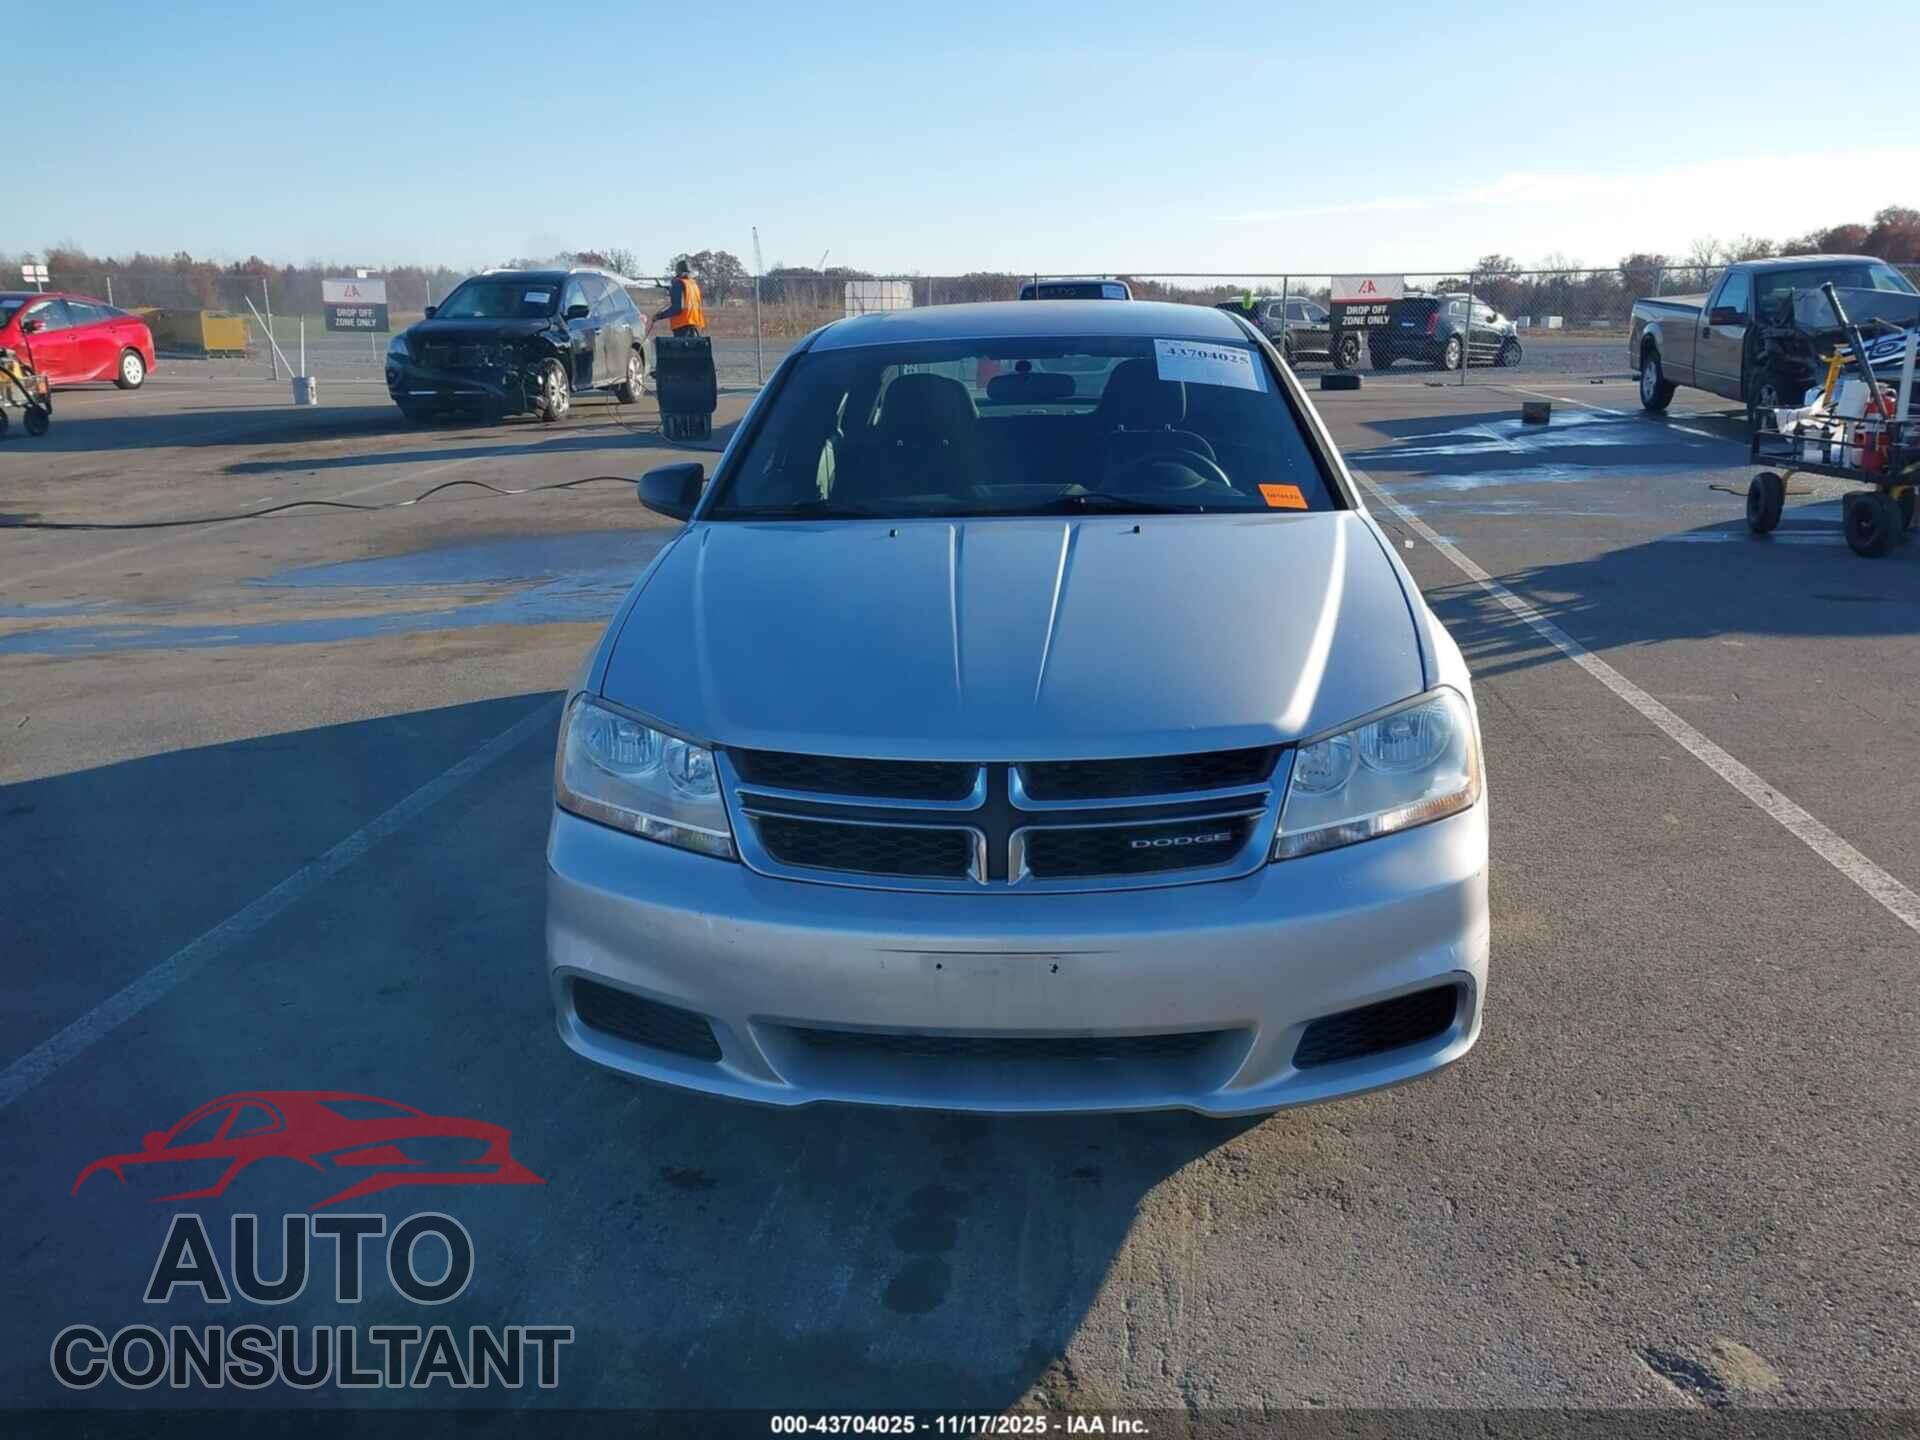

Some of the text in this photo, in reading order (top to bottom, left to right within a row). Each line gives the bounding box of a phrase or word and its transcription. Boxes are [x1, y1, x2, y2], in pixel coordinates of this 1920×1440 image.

[1346, 304, 1388, 315] DROP OFF
[356, 318, 376, 327] ONLY
[1342, 315, 1391, 325] ZONE ONLY
[1131, 832, 1232, 849] DODGE
